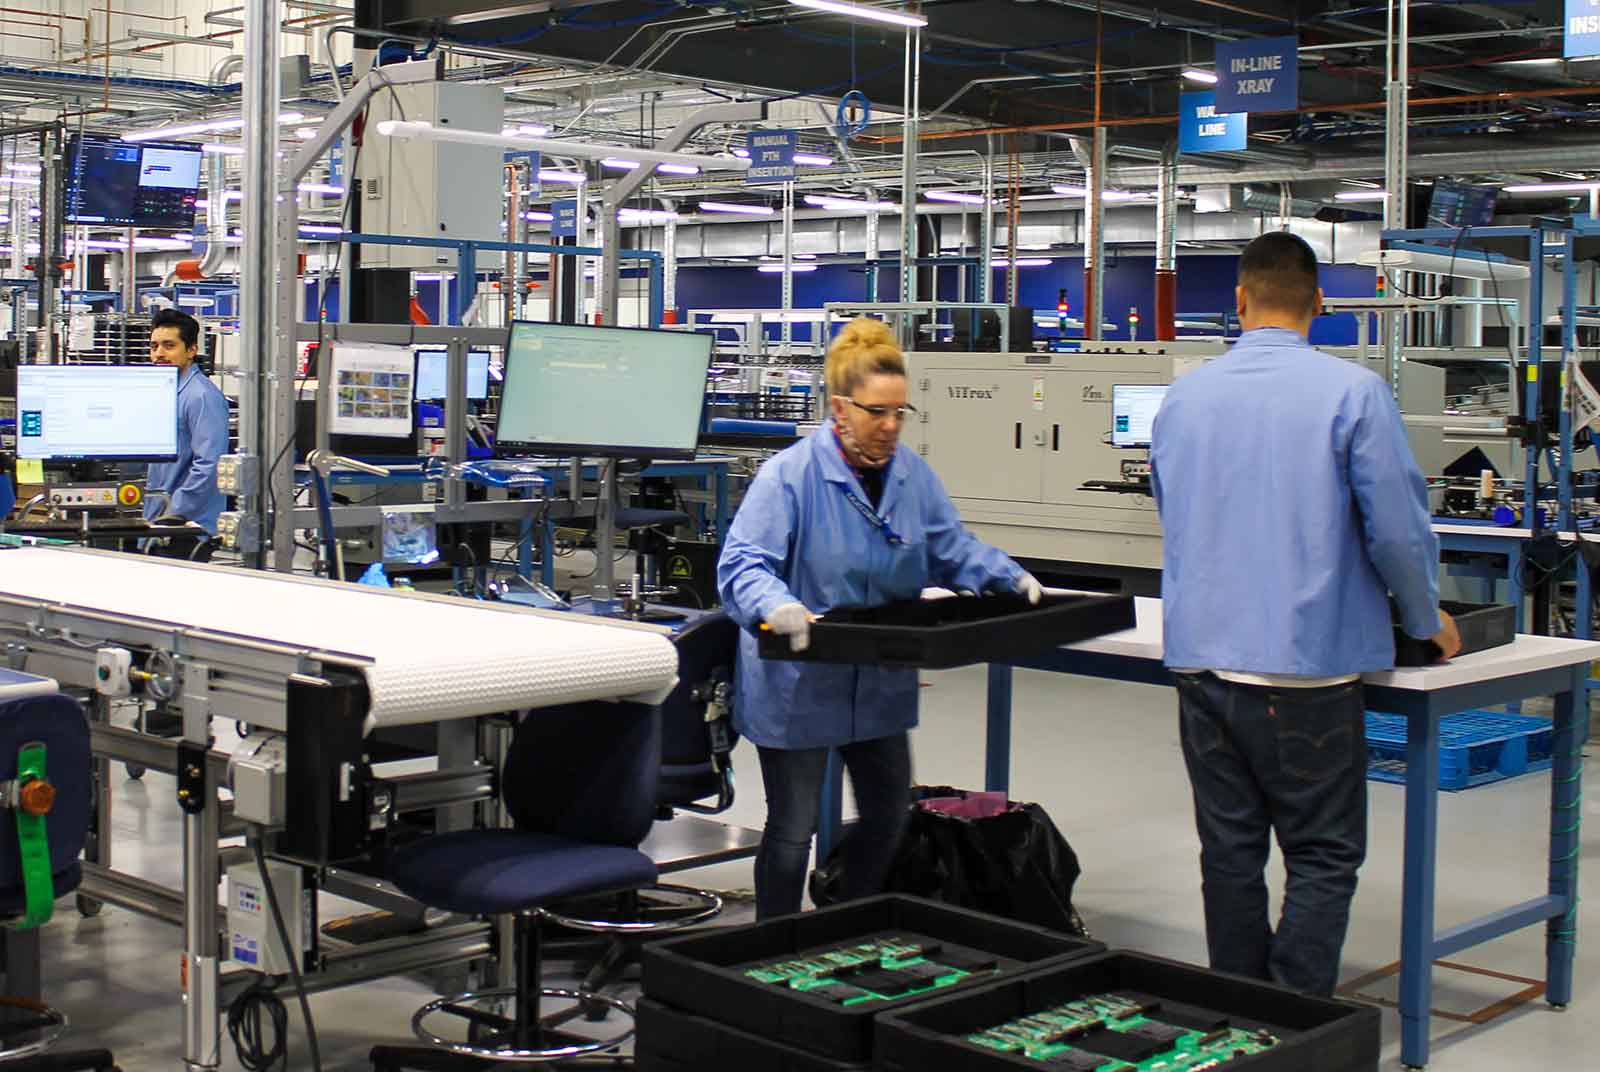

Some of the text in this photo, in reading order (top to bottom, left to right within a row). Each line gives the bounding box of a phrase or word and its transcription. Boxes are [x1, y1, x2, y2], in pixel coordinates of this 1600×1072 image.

[1569, 15, 1600, 34] INS
[1231, 55, 1282, 73] IN-LINE
[1237, 78, 1275, 95] XRAY
[1196, 105, 1229, 118] WA
[1198, 123, 1226, 136] LINE
